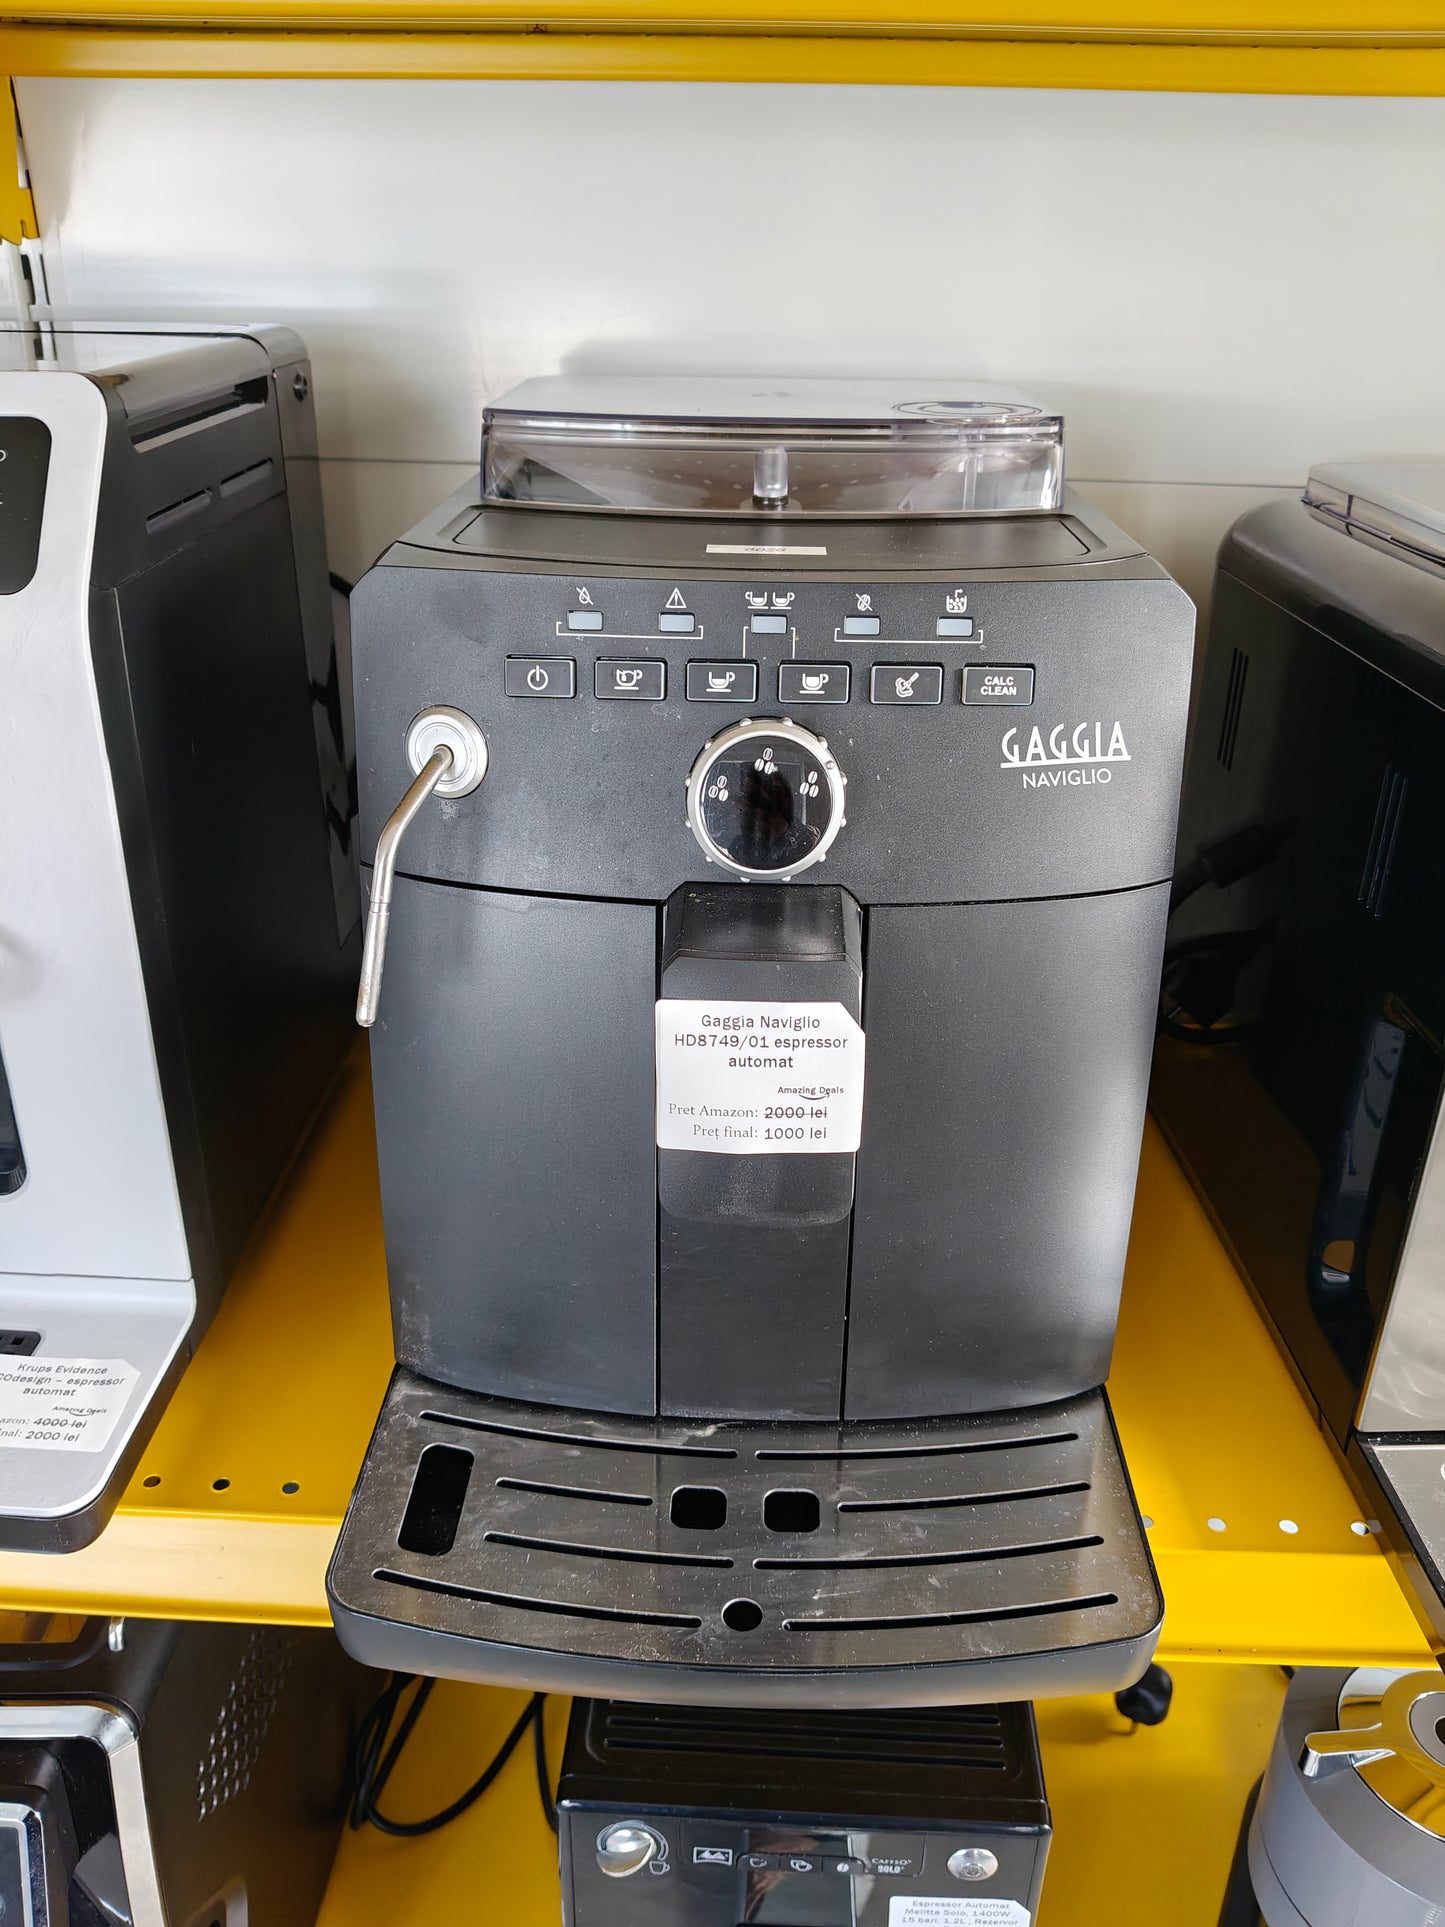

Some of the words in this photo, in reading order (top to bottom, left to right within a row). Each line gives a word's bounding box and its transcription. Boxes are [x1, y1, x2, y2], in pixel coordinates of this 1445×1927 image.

[984, 676, 1015, 686] CALC
[980, 686, 1017, 696] CLEAN
[1001, 721, 1131, 767] GAGGIA
[1022, 768, 1112, 789] NAVIGLIO
[701, 1014, 755, 1031] Gaggia
[760, 1015, 821, 1031] Naviglio
[674, 1034, 770, 1051] HD8749/01
[774, 1036, 849, 1051] espressor
[728, 1056, 794, 1068] automat
[778, 1086, 816, 1095] Amazing
[819, 1086, 844, 1095] Deals
[669, 1103, 695, 1116] Pret
[699, 1104, 759, 1118] Amazon:
[764, 1106, 806, 1119] 2000
[810, 1106, 828, 1119] lei
[724, 1125, 759, 1138] final:
[764, 1127, 805, 1140] 1000
[810, 1127, 827, 1139] lei
[17, 1363, 52, 1375] Krups
[55, 1365, 109, 1375] Evidence
[66, 1377, 126, 1387] espressor
[23, 1387, 77, 1397] automat
[52, 1406, 85, 1414] Amazing
[33, 1418, 69, 1427] 4000
[70, 1419, 88, 1428] lei
[25, 1430, 61, 1441] 2000
[63, 1433, 81, 1442] lei
[912, 1900, 962, 1908] Espressor
[904, 1908, 941, 1916] Melitta
[974, 1918, 1019, 1926] Rezervor
